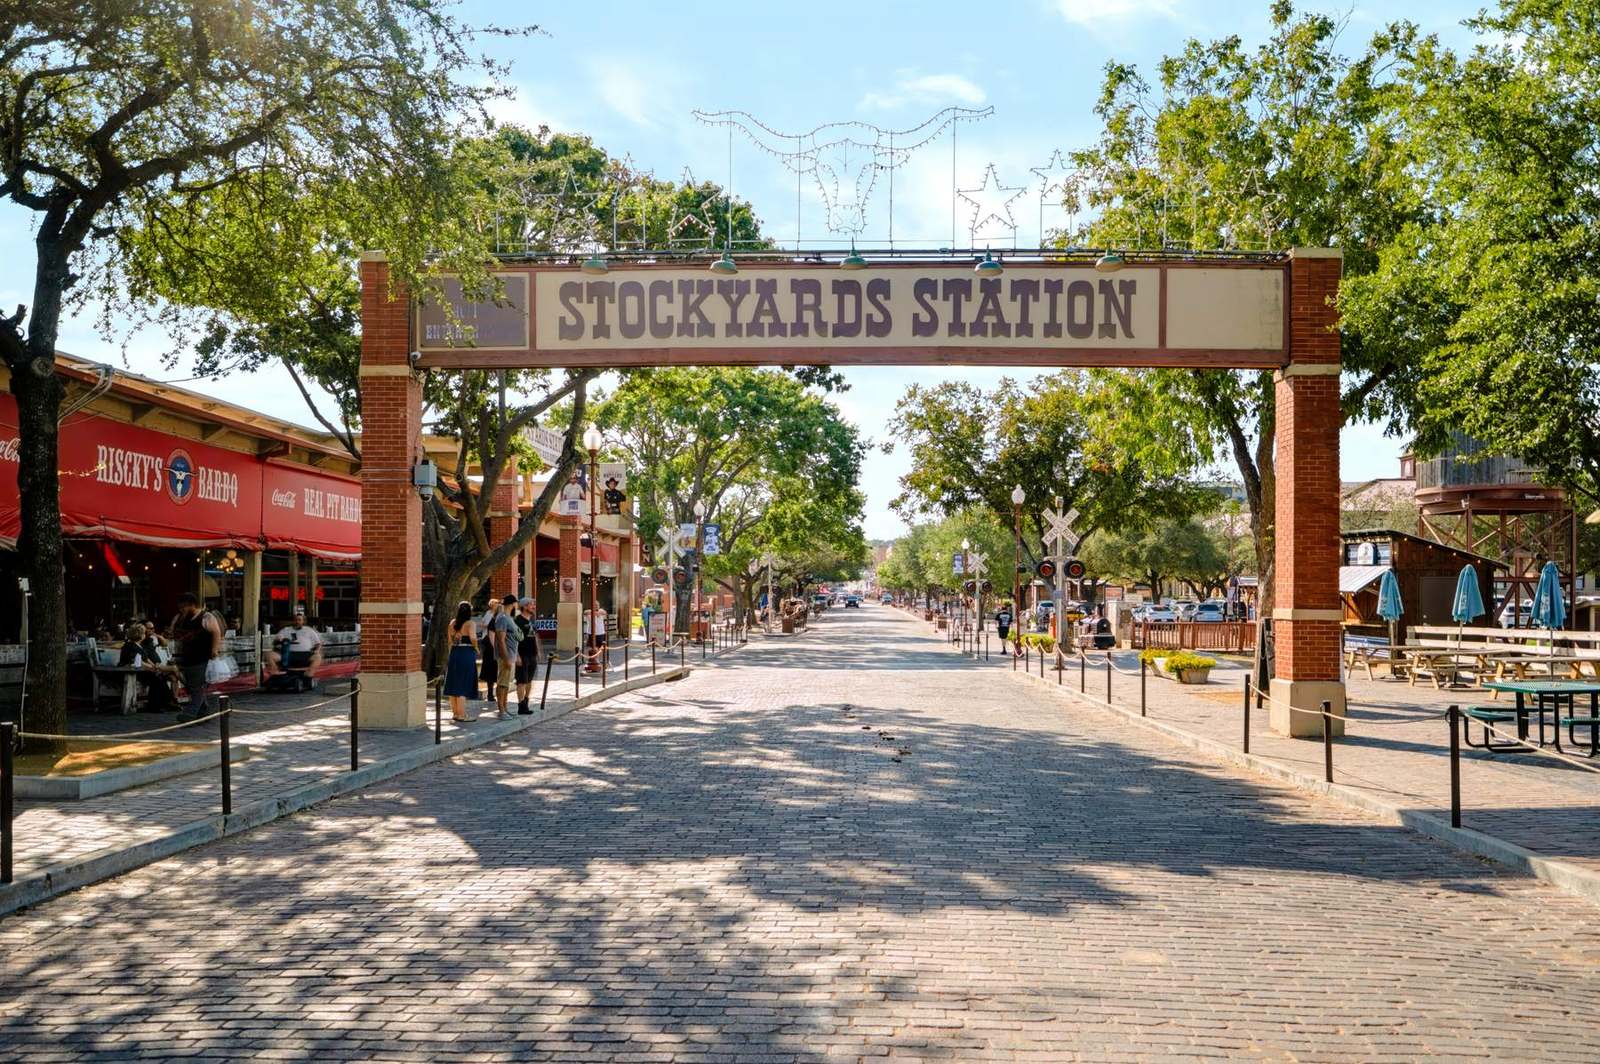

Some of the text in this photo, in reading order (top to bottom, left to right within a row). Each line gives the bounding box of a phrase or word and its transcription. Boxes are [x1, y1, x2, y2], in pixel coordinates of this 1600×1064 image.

[558, 278, 1136, 342] STOCKYARDS STATION
[96, 444, 164, 493] RISCKY'S
[303, 487, 325, 519] REAL
[326, 492, 340, 521] PIT
